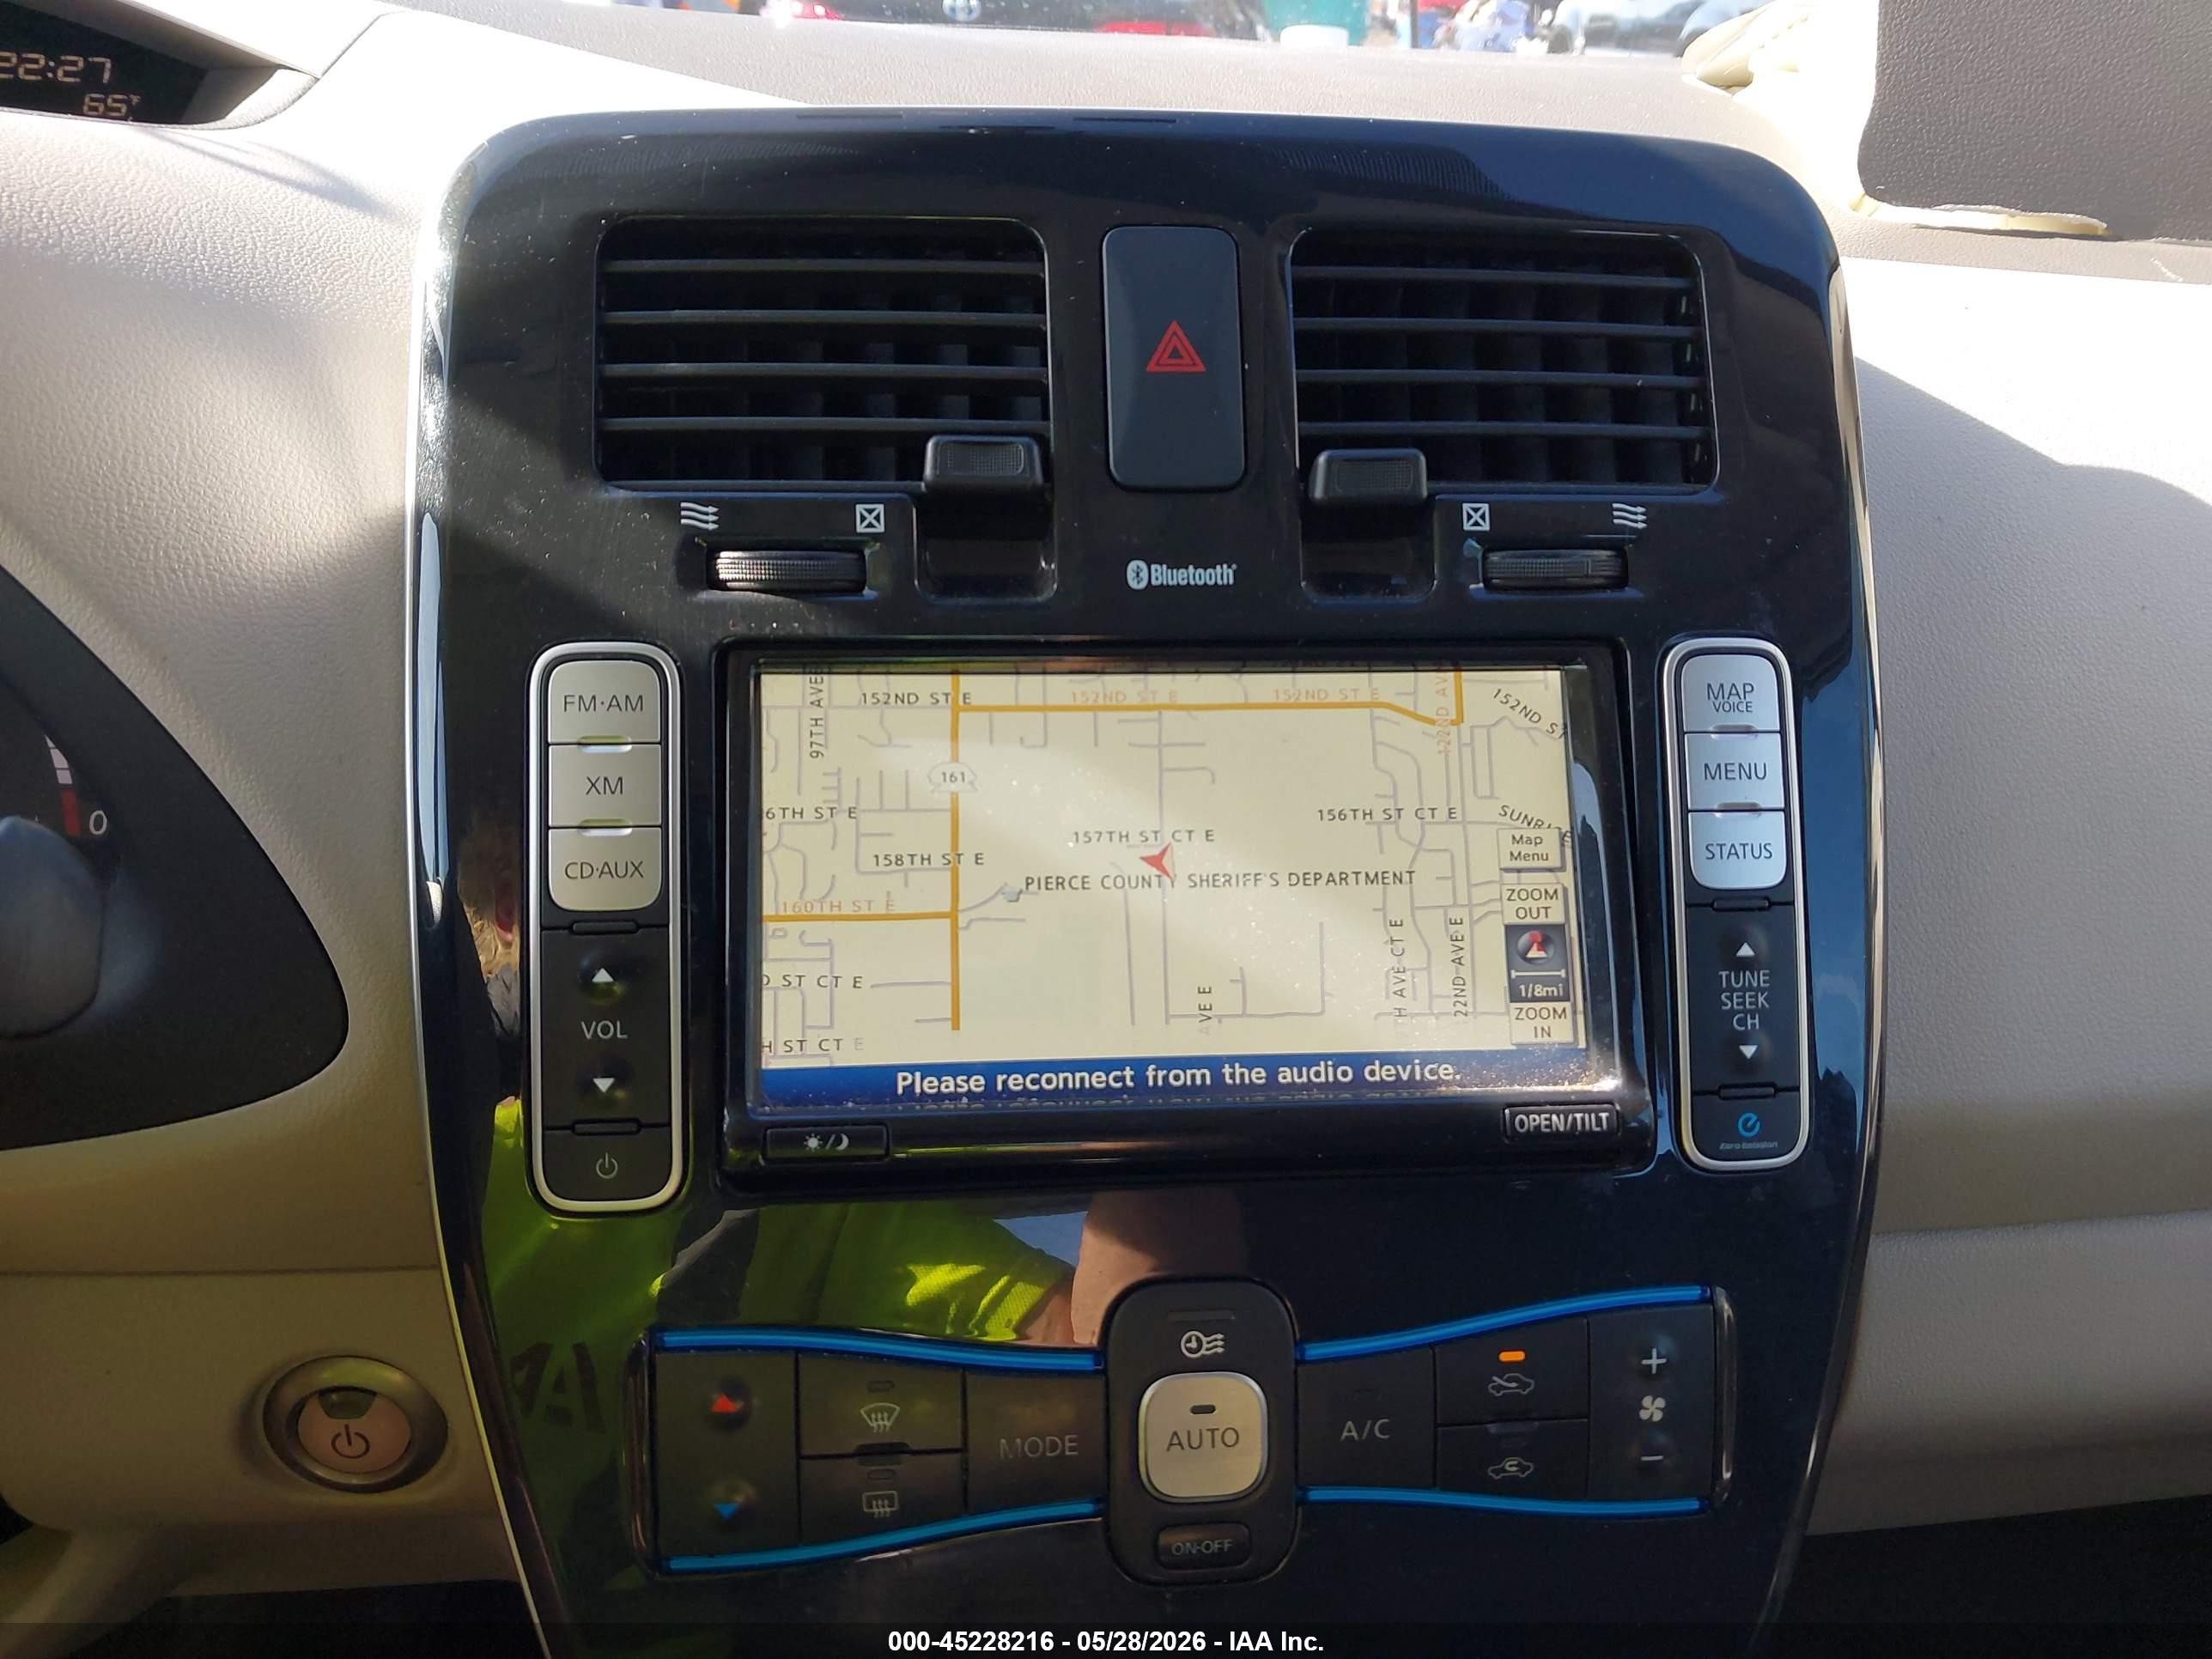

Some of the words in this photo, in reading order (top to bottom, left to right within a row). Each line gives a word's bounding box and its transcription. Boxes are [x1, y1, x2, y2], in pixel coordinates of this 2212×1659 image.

[809, 675, 824, 708] AVE
[861, 691, 919, 706] 152ND
[930, 692, 951, 705] ST
[962, 692, 972, 705] E
[1071, 690, 1127, 704] 152ND
[1137, 690, 1158, 703] ST
[1169, 690, 1179, 702] E
[1273, 689, 1329, 702] 152ND
[1340, 689, 1361, 701] ST
[1370, 689, 1380, 701] E
[1706, 683, 1755, 701] MAP
[1493, 688, 1542, 724] 152ND
[1711, 701, 1753, 713] VOICE
[810, 717, 825, 759] 97TH
[941, 771, 967, 783] 161
[1704, 763, 1768, 781] MENU
[585, 775, 624, 795] XM
[765, 806, 804, 820] 6TH
[814, 807, 837, 819] ST
[848, 806, 858, 819] E
[1317, 808, 1373, 822] 156TH
[1382, 808, 1404, 821] ST
[1415, 808, 1439, 820] CT
[1448, 808, 1457, 820] E
[1073, 830, 1130, 843] 157TH
[1140, 830, 1161, 842] ST
[1171, 830, 1195, 842] CT
[1205, 830, 1215, 842] E
[1511, 834, 1544, 848] Map
[1509, 850, 1549, 861] Menu
[1705, 842, 1773, 860] STATUS
[873, 853, 932, 867] 158TH
[941, 854, 964, 866] ST
[975, 854, 985, 866] E
[1025, 875, 1091, 891] PIERCE
[1100, 873, 1177, 890] COUNTY
[1187, 872, 1280, 889] SHERIFF'S
[1287, 870, 1416, 887] DEPARTMENT
[1505, 888, 1559, 902] ZOOM
[781, 899, 842, 915] 160TH
[852, 899, 874, 912] ST
[885, 899, 896, 912] E
[1515, 906, 1553, 920] OUT
[1389, 919, 1403, 927] E
[1449, 917, 1463, 926] E
[1390, 936, 1405, 957] CT
[1449, 934, 1466, 966] AVE
[781, 975, 805, 988] ST
[817, 975, 842, 988] CT
[853, 975, 863, 989] E
[1393, 966, 1407, 999] AVE
[1718, 969, 1771, 988] TUNE
[1197, 986, 1212, 994] E
[1452, 975, 1468, 1018] 22ND
[1518, 983, 1565, 999] 1/8mi
[1720, 991, 1770, 1010] SEEK
[1514, 1007, 1567, 1021] ZOOM
[1732, 1013, 1759, 1030] CH
[580, 1020, 629, 1040] VOL
[1533, 1025, 1553, 1038] IN
[783, 1039, 808, 1053] ST
[818, 1038, 843, 1052] CT
[896, 1071, 986, 1095] Please
[995, 1066, 1134, 1091] reconnect
[1145, 1064, 1212, 1087] from
[1222, 1062, 1267, 1085] the
[1277, 1060, 1354, 1084] audio
[1364, 1059, 1462, 1082] device.
[1514, 1111, 1610, 1133] OPEN/TILT
[1340, 1418, 1391, 1441] A/C
[999, 1434, 1079, 1459] MODE
[1165, 1427, 1241, 1451] AUTO
